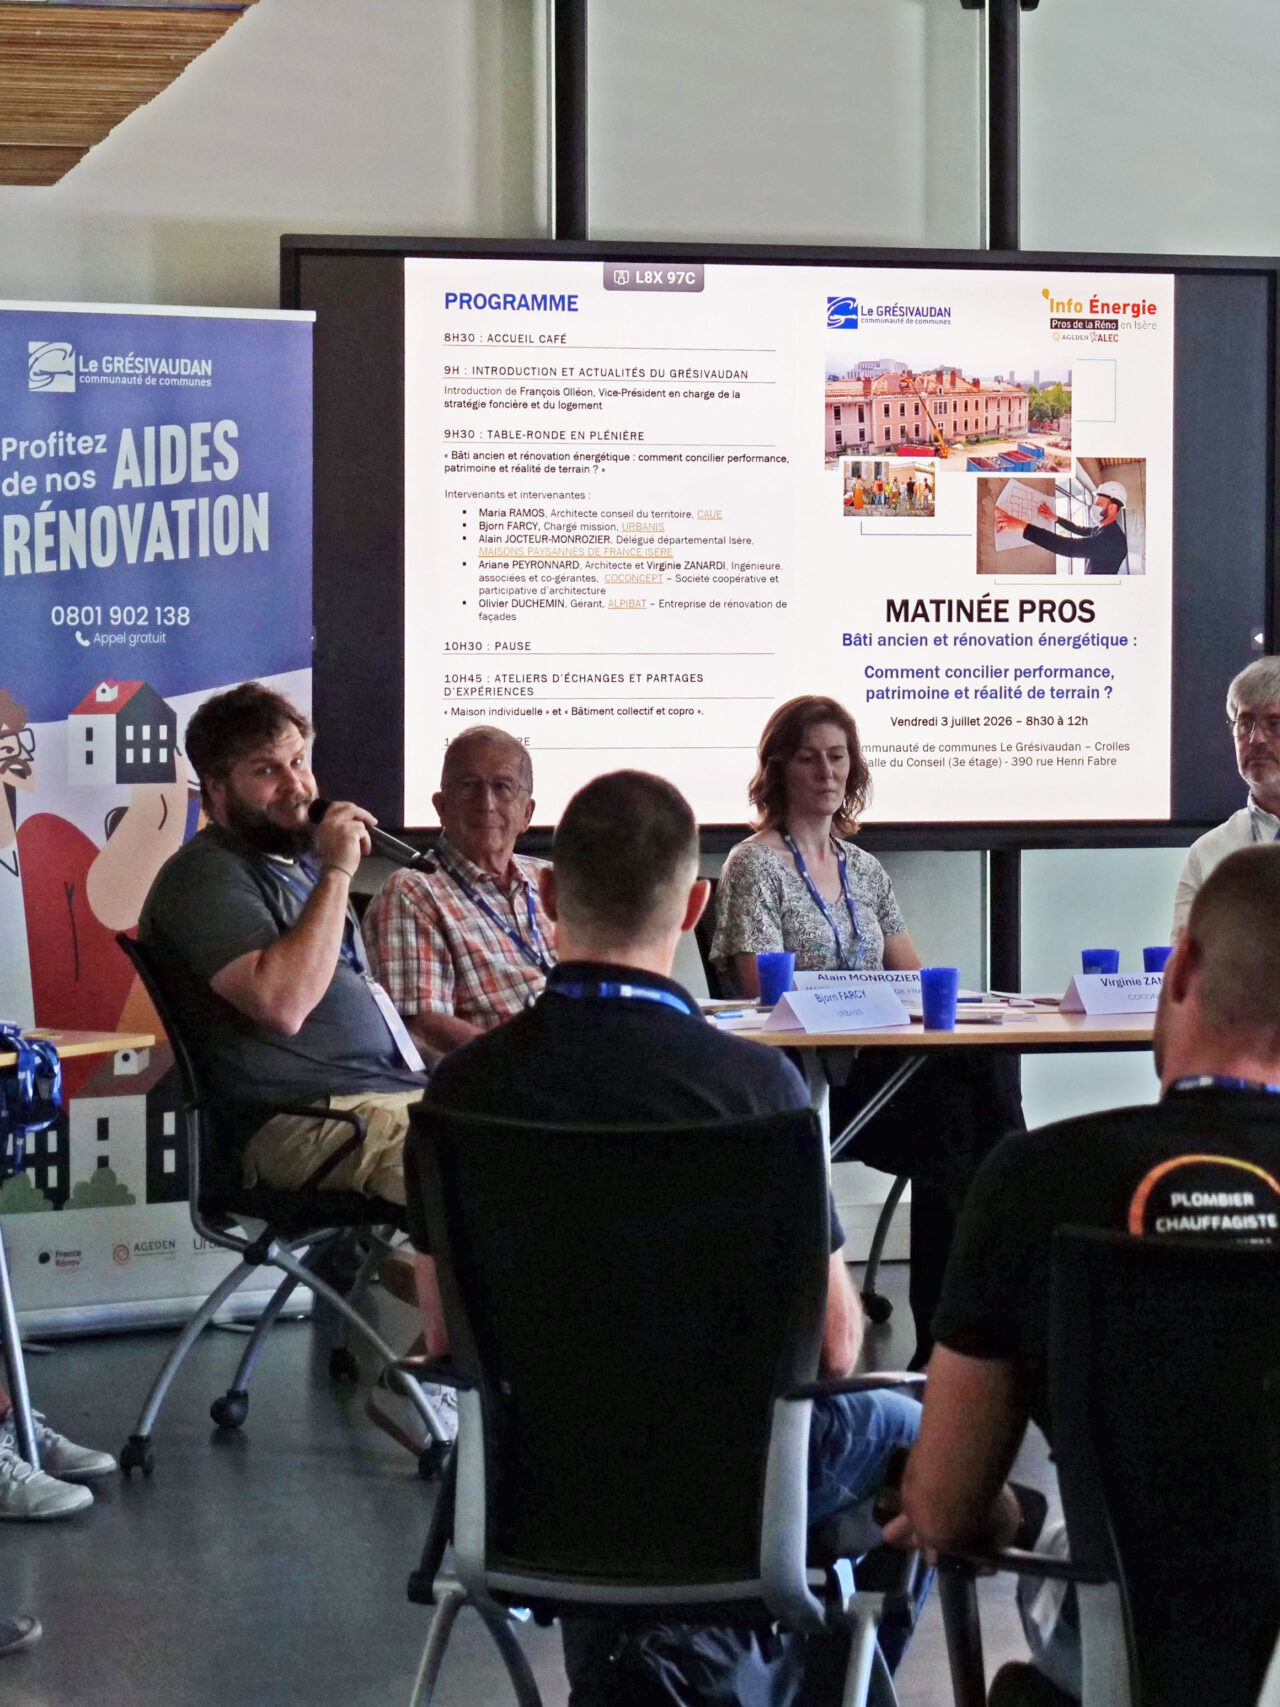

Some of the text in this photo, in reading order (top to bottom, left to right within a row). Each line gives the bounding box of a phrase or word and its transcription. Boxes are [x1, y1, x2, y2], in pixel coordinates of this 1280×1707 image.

[636, 270, 696, 285] L8X 97C
[445, 292, 578, 313] PROGRAMME
[861, 302, 951, 318] Le GRÉSIVAUDAN
[1049, 293, 1158, 319] Info Énergie
[444, 332, 566, 345] 8H30 ACCUEIL CAFÉ
[79, 352, 212, 375] Le GRÉSIVAUDAN
[444, 365, 747, 380] 9H INTRODUCTION ET ACTUALITÉS DU GRÉSIVAUDAN
[80, 375, 211, 387] communauté de communes
[445, 385, 502, 396] Introduction
[505, 386, 516, 396] de
[520, 386, 560, 399] François
[599, 387, 666, 398] Vice-Président
[669, 390, 680, 398] en
[683, 389, 715, 401] charge
[718, 389, 729, 399] de
[733, 389, 740, 399] la
[444, 398, 602, 412] stratégie foncière et du logement
[444, 429, 644, 441] 9H30 TABLE-RONDE EN PLÉNIÈRE
[1, 431, 107, 461] Profitez
[113, 419, 239, 489] AIDES
[1, 469, 96, 496] de nos
[3, 492, 269, 577] RÉNOVATION
[51, 605, 190, 626] 0801 902 138
[887, 592, 1095, 624] MATINÉE PROS
[94, 631, 166, 648] Appel gratuit
[445, 641, 531, 651] 10H30 PAUSE
[843, 632, 1128, 650] Bâti ancien et rénovation énergétique
[445, 673, 482, 684] 10H45
[495, 673, 547, 684] ATELIERS
[630, 673, 642, 683] ET
[647, 673, 703, 683] PARTAGES
[865, 664, 1114, 682] Comment concilier performance,
[866, 685, 949, 703] patrimoine
[955, 686, 969, 700] et
[975, 684, 1022, 700] réalité
[1027, 685, 1045, 700] de
[1050, 685, 1099, 700] terrain
[891, 715, 1088, 729] Vendredi 3 juillet 2026 8h30 à 12h
[861, 741, 1130, 753] mmunauté de communes Le Grésivaudan Crolles
[818, 973, 920, 983] Alain MONROZIER
[1100, 977, 1142, 988] Virginie
[839, 989, 867, 1000] FARCY
[1170, 1191, 1255, 1208] PLOMBIER
[1155, 1213, 1278, 1233] CHAUFFAGISTE
[134, 1240, 175, 1252] AGEDEN
